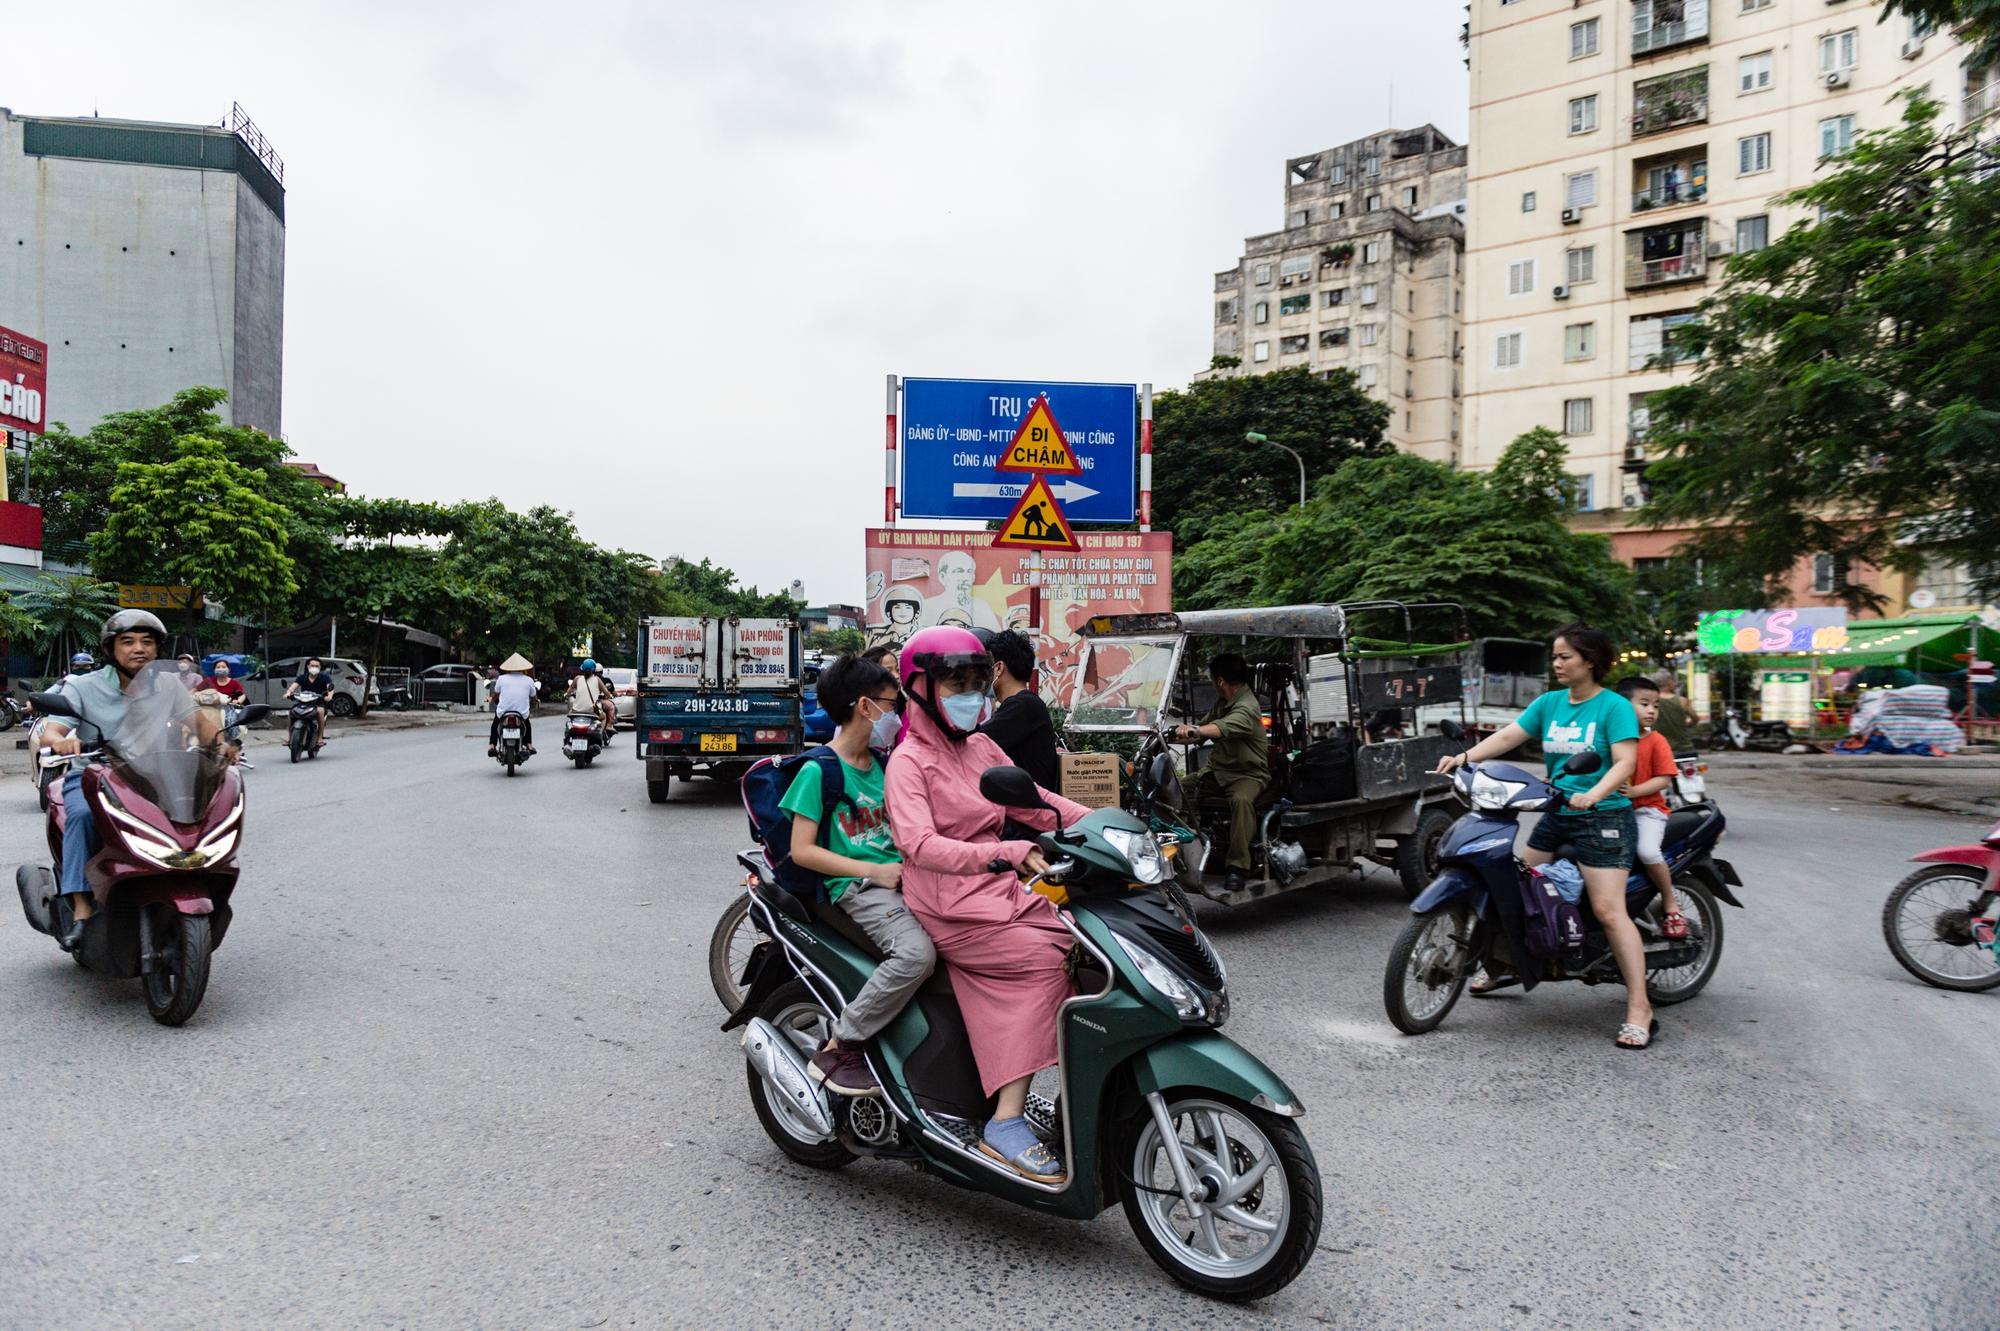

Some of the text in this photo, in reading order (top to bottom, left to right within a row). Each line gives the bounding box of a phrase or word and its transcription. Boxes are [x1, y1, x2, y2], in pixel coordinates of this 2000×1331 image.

[0, 373, 41, 424] CÁO
[989, 396, 1021, 421] TRỤ
[908, 423, 934, 440] ĐẢNG
[1088, 430, 1115, 445] CÔNG
[1031, 426, 1048, 442] ĐI
[953, 451, 1095, 470] CÔNG AN ÔNG
[1013, 445, 1065, 466] CHẬM
[999, 485, 1022, 497] 630m
[893, 532, 912, 545] BAN
[915, 531, 940, 546] NHÂN
[943, 532, 962, 546] DÂN
[1105, 535, 1124, 550] ĐẠO
[1126, 535, 1142, 548] 197
[1019, 558, 1046, 570] PHG
[740, 629, 783, 642] VĂN PHÒNG
[653, 646, 672, 657] TRỌN
[753, 646, 770, 658] TRỌN
[662, 664, 676, 673] 0912
[741, 664, 754, 674] 039
[755, 664, 768, 674] 392
[711, 734, 727, 743] 29H
[704, 743, 733, 751] 243.86
[1072, 1013, 1108, 1034] HONDA
